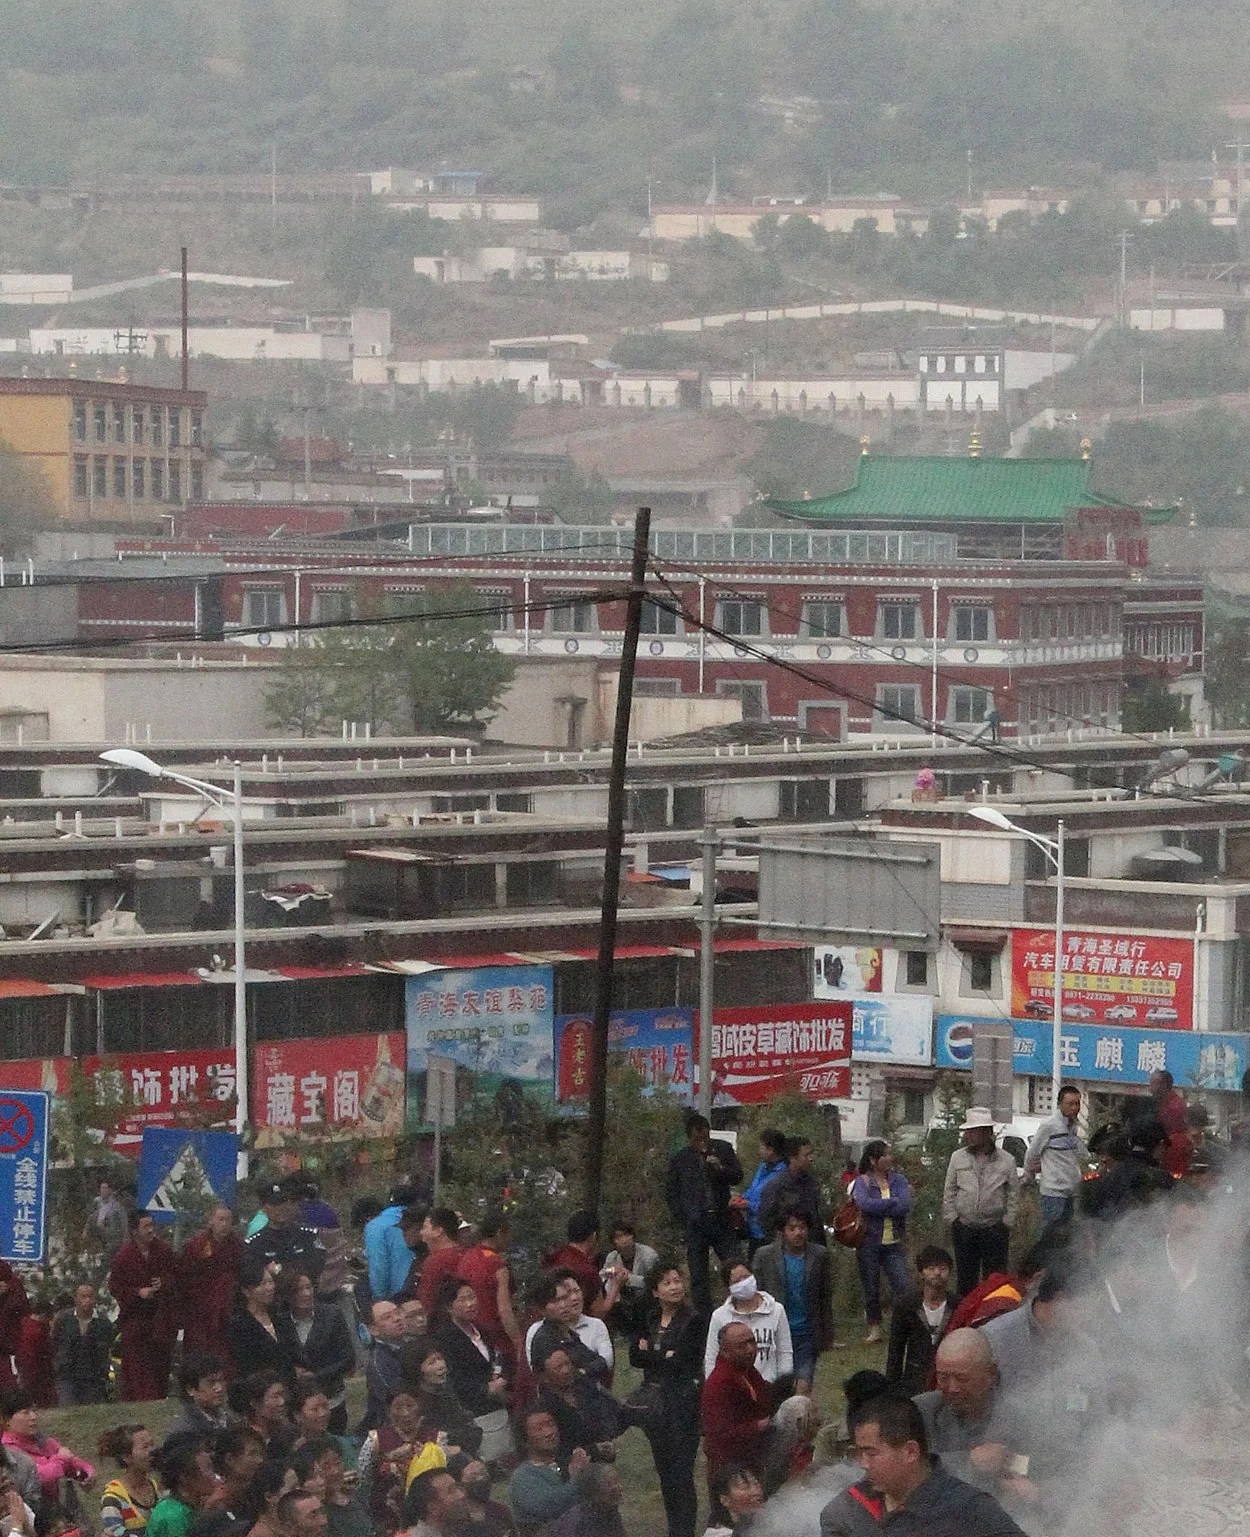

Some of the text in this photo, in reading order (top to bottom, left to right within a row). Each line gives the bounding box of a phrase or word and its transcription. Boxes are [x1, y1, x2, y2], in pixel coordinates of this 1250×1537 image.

[1066, 936, 1147, 958] 青海圣域行
[574, 1032, 588, 1086] 王老吉
[800, 1071, 840, 1092] 可口可乐
[267, 1069, 359, 1126] 藏宝阁
[13, 1156, 39, 1255] 全线禁止停车
